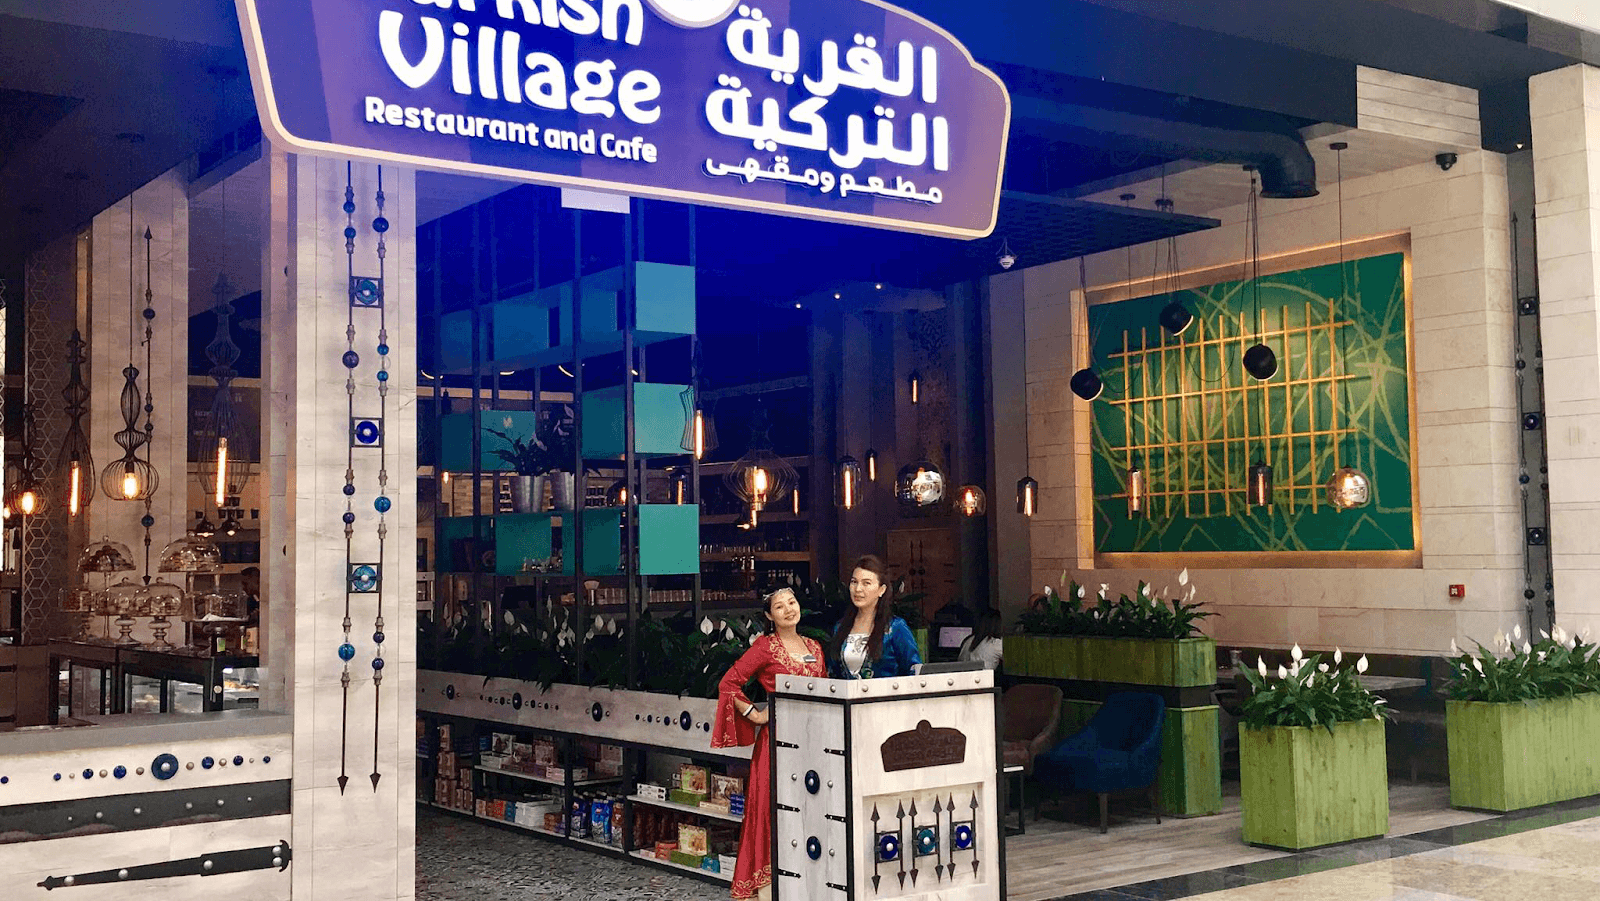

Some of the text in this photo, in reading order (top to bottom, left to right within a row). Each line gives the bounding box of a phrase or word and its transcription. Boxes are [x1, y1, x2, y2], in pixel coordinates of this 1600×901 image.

[378, 11, 661, 124] Village
[726, 4, 938, 103] القرية
[365, 96, 658, 163] Restaurant and Cafe
[705, 73, 949, 171] التركية
[705, 155, 943, 204] مطعم ومقهى
